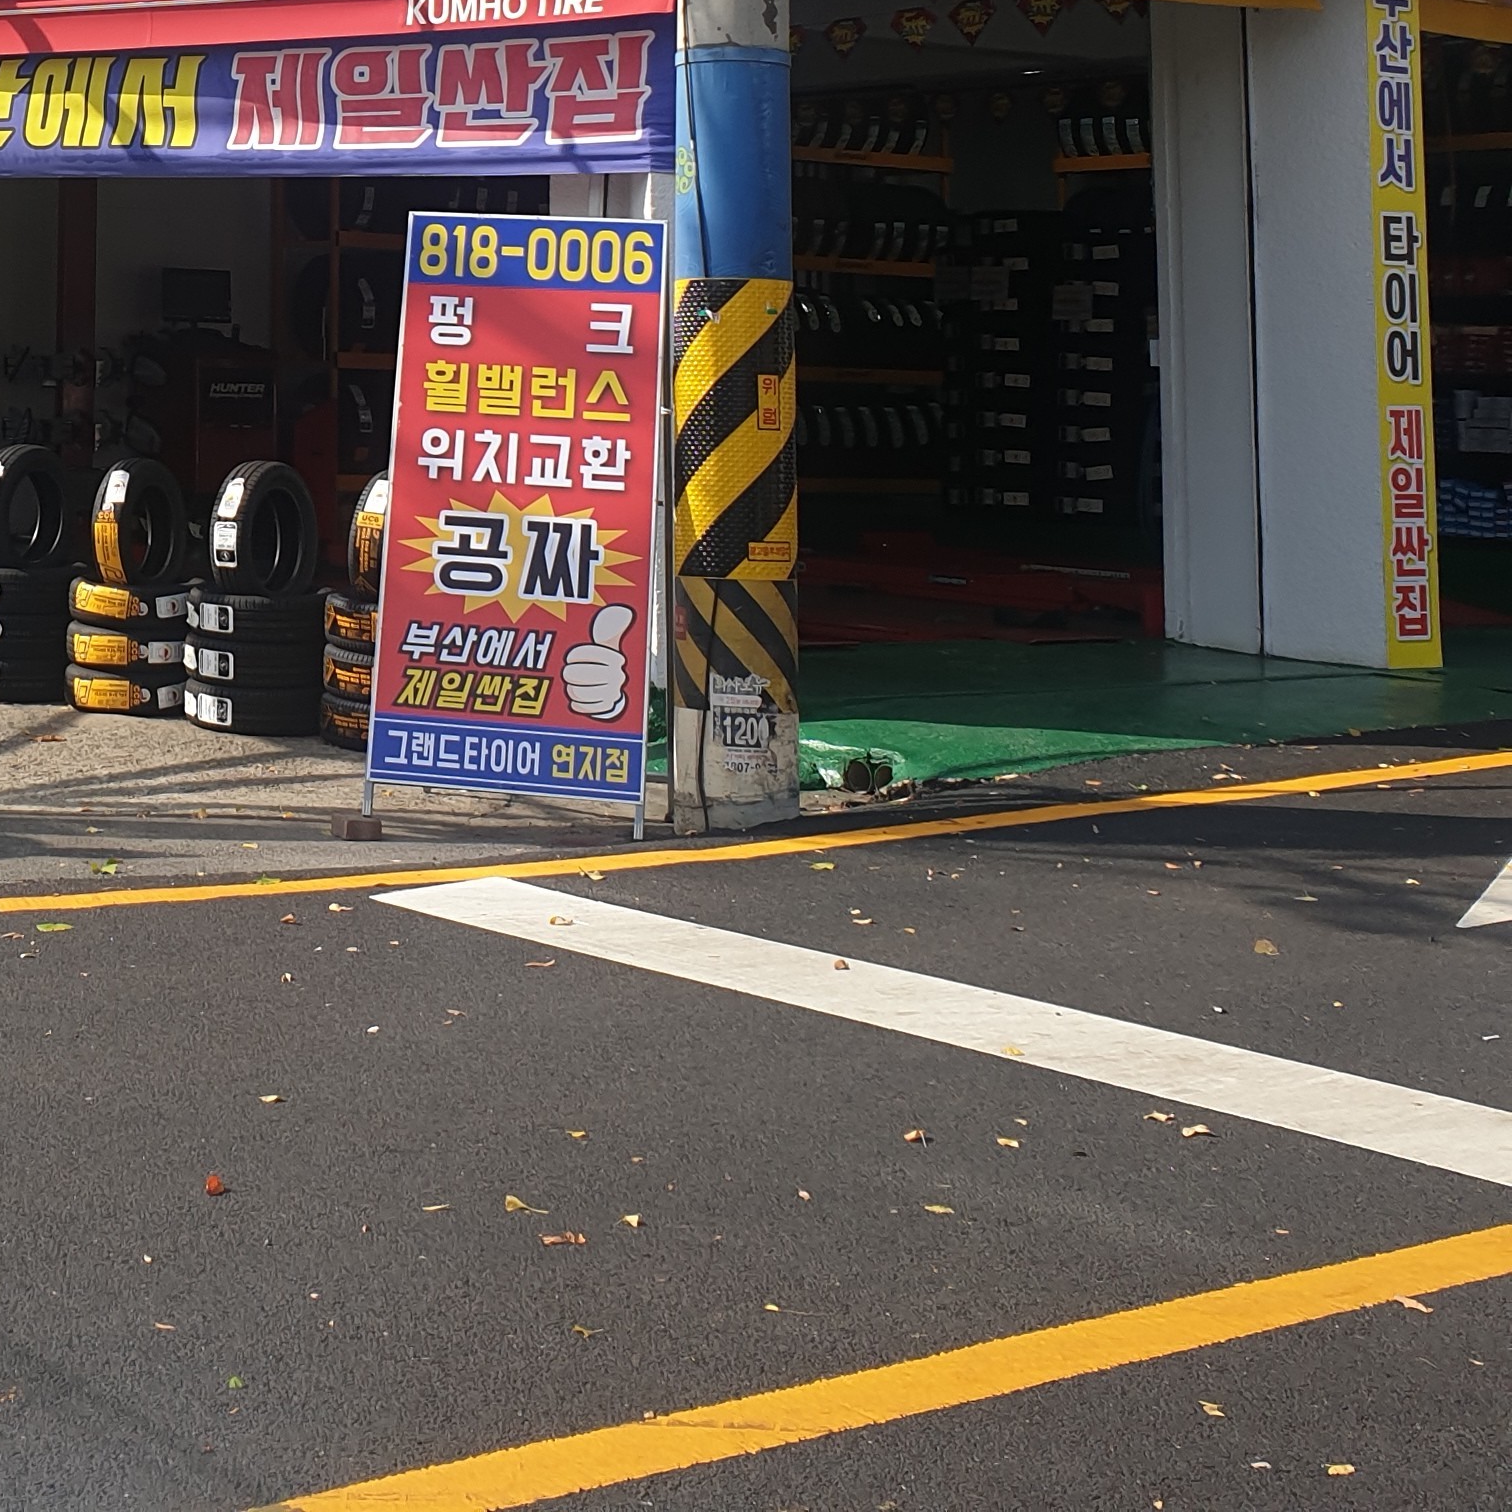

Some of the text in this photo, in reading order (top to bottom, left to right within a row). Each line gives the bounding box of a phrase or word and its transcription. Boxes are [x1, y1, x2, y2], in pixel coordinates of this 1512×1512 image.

[226, 29, 656, 152] 제일싼집
[418, 223, 655, 286] 818-0006
[427, 295, 635, 355] 펑 크
[1381, 212, 1422, 386] 타이어
[422, 359, 632, 423] 휠밸런스
[416, 427, 632, 492] 위치교환
[1387, 405, 1432, 641] 제일싼집
[432, 510, 605, 604] 공짜
[401, 621, 554, 670] 부산에서
[395, 668, 551, 717] 제일싼집
[384, 728, 630, 785] 그랜드타이어 연지점
